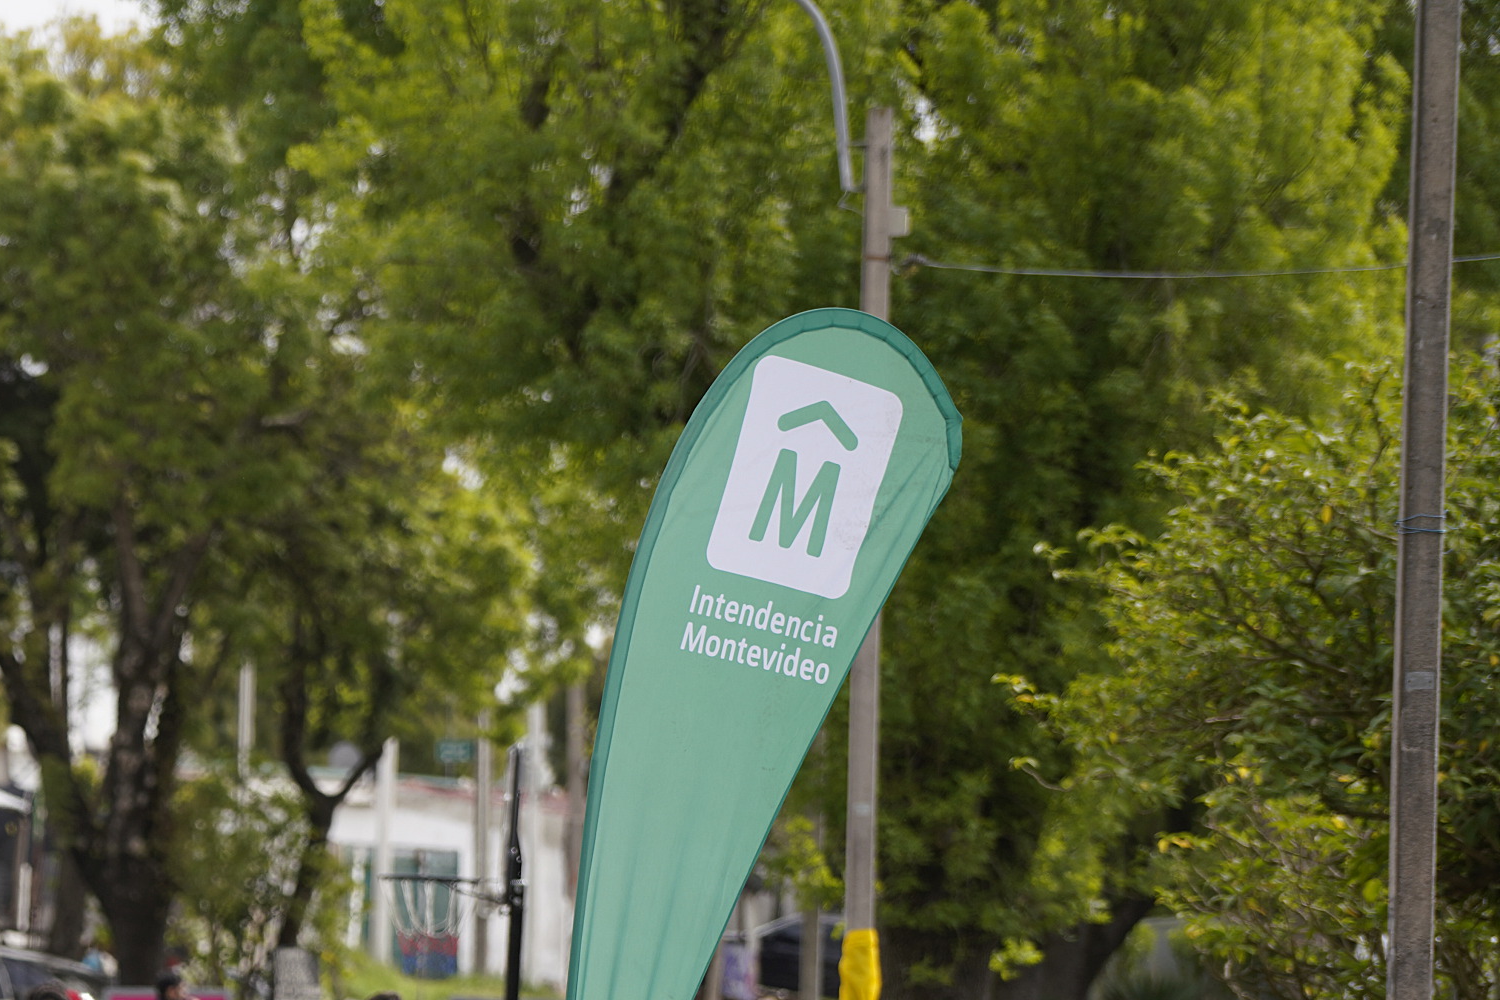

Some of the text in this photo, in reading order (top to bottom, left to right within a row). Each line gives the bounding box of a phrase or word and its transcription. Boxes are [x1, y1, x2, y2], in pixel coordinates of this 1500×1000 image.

[748, 448, 841, 558] M
[689, 584, 838, 648] Intendencia
[680, 621, 830, 684] Montevideo
